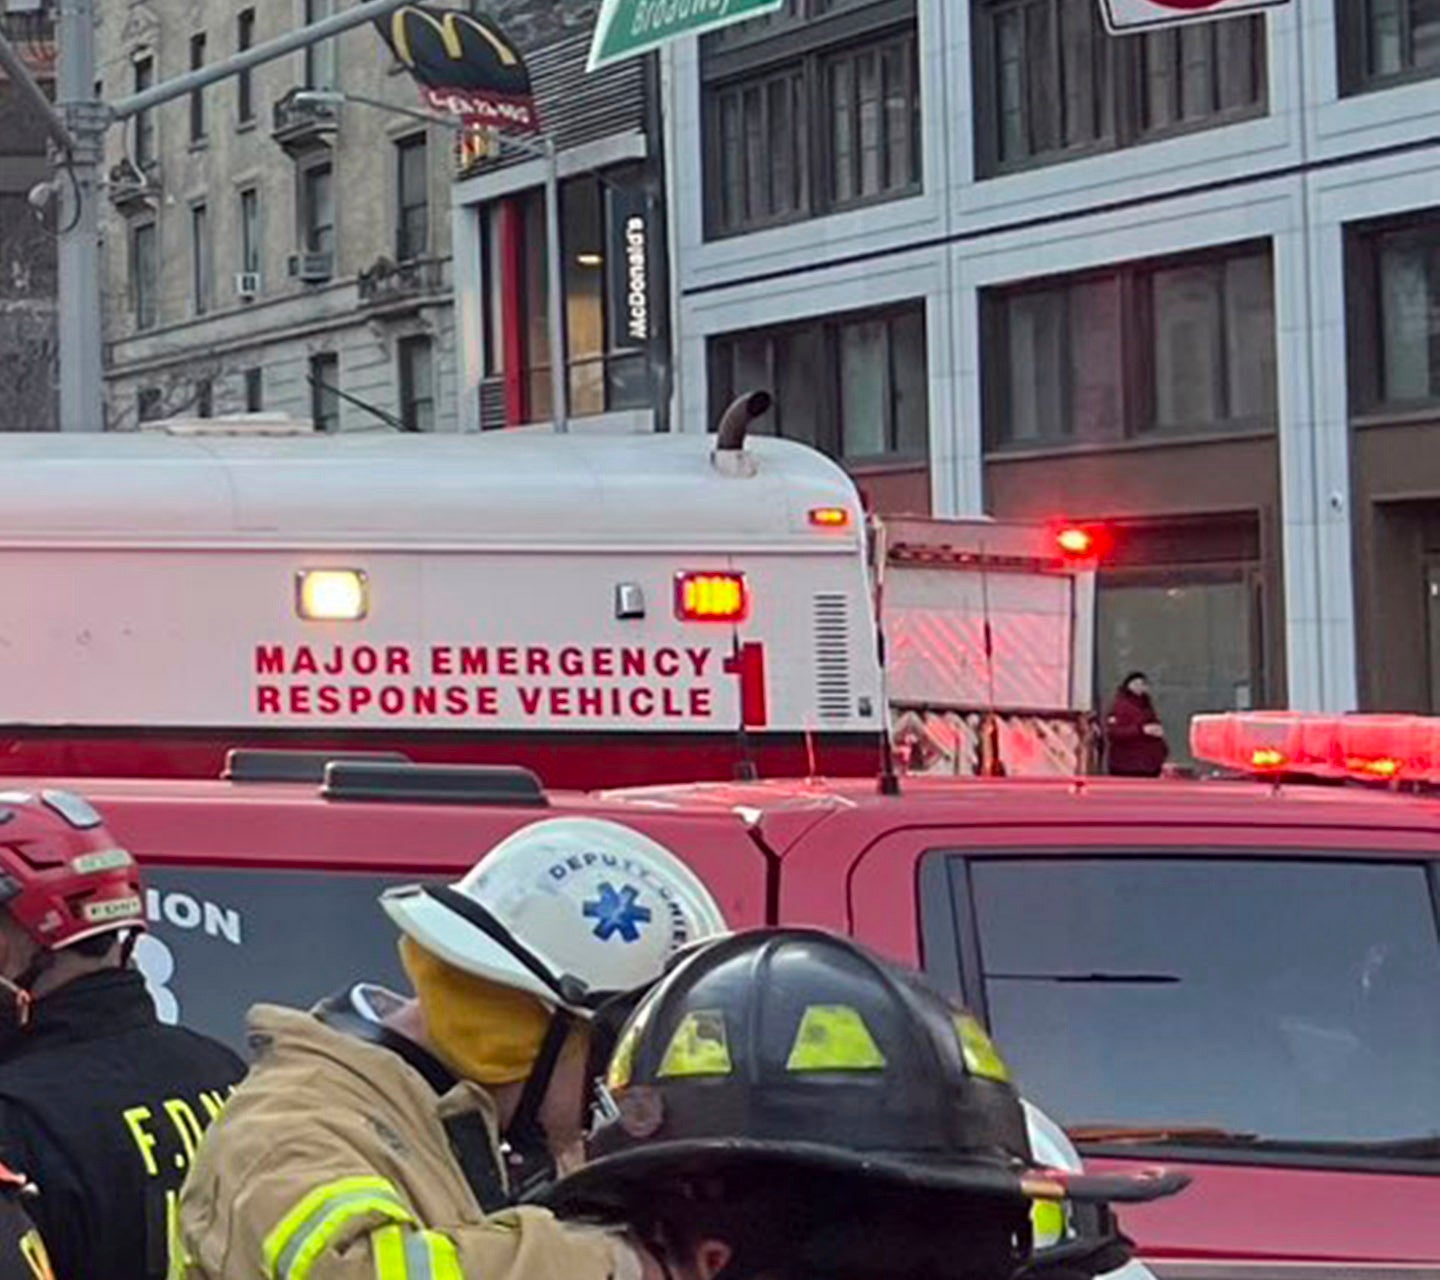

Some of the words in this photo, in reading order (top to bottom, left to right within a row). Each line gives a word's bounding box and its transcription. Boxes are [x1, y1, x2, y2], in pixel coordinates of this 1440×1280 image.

[626, 216, 647, 340] McDonald's
[255, 646, 411, 676] MAJOR
[431, 646, 713, 678] EMERGENCY
[723, 641, 767, 727] 1
[256, 685, 500, 716] RESPONSE
[517, 686, 713, 717] VEHICLE
[549, 852, 651, 881] DEPUTY
[146, 888, 241, 945] ION
